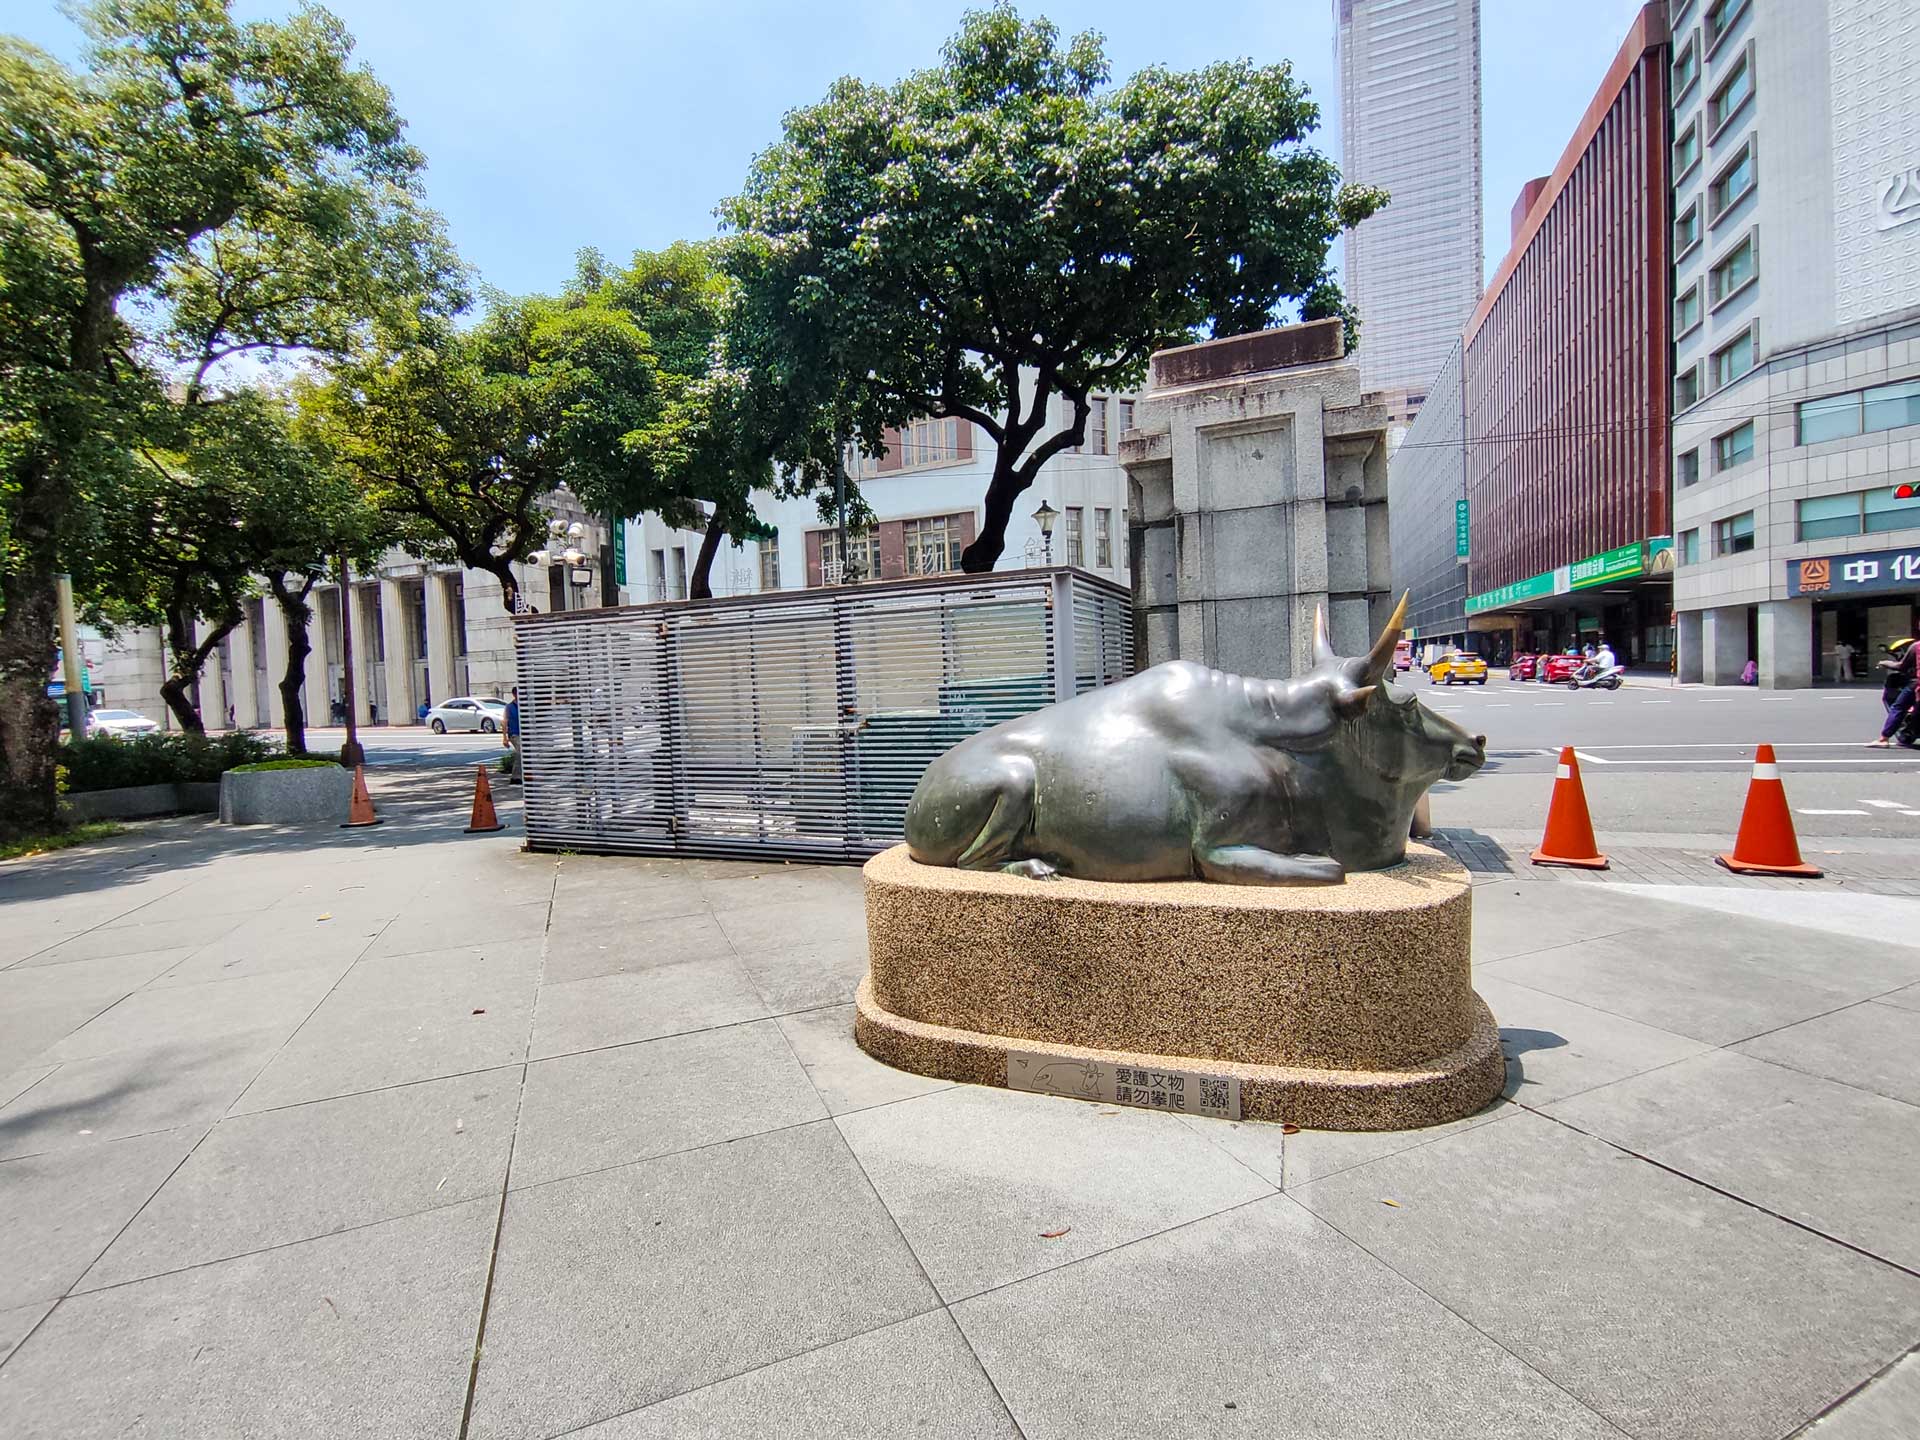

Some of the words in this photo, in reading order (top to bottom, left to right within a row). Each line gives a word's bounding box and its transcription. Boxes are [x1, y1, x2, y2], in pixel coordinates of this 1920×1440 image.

[1799, 583, 1831, 592] CCPC
[1115, 1067, 1185, 1092] 愛護文物
[1115, 1085, 1185, 1110] 請勿攀爬
